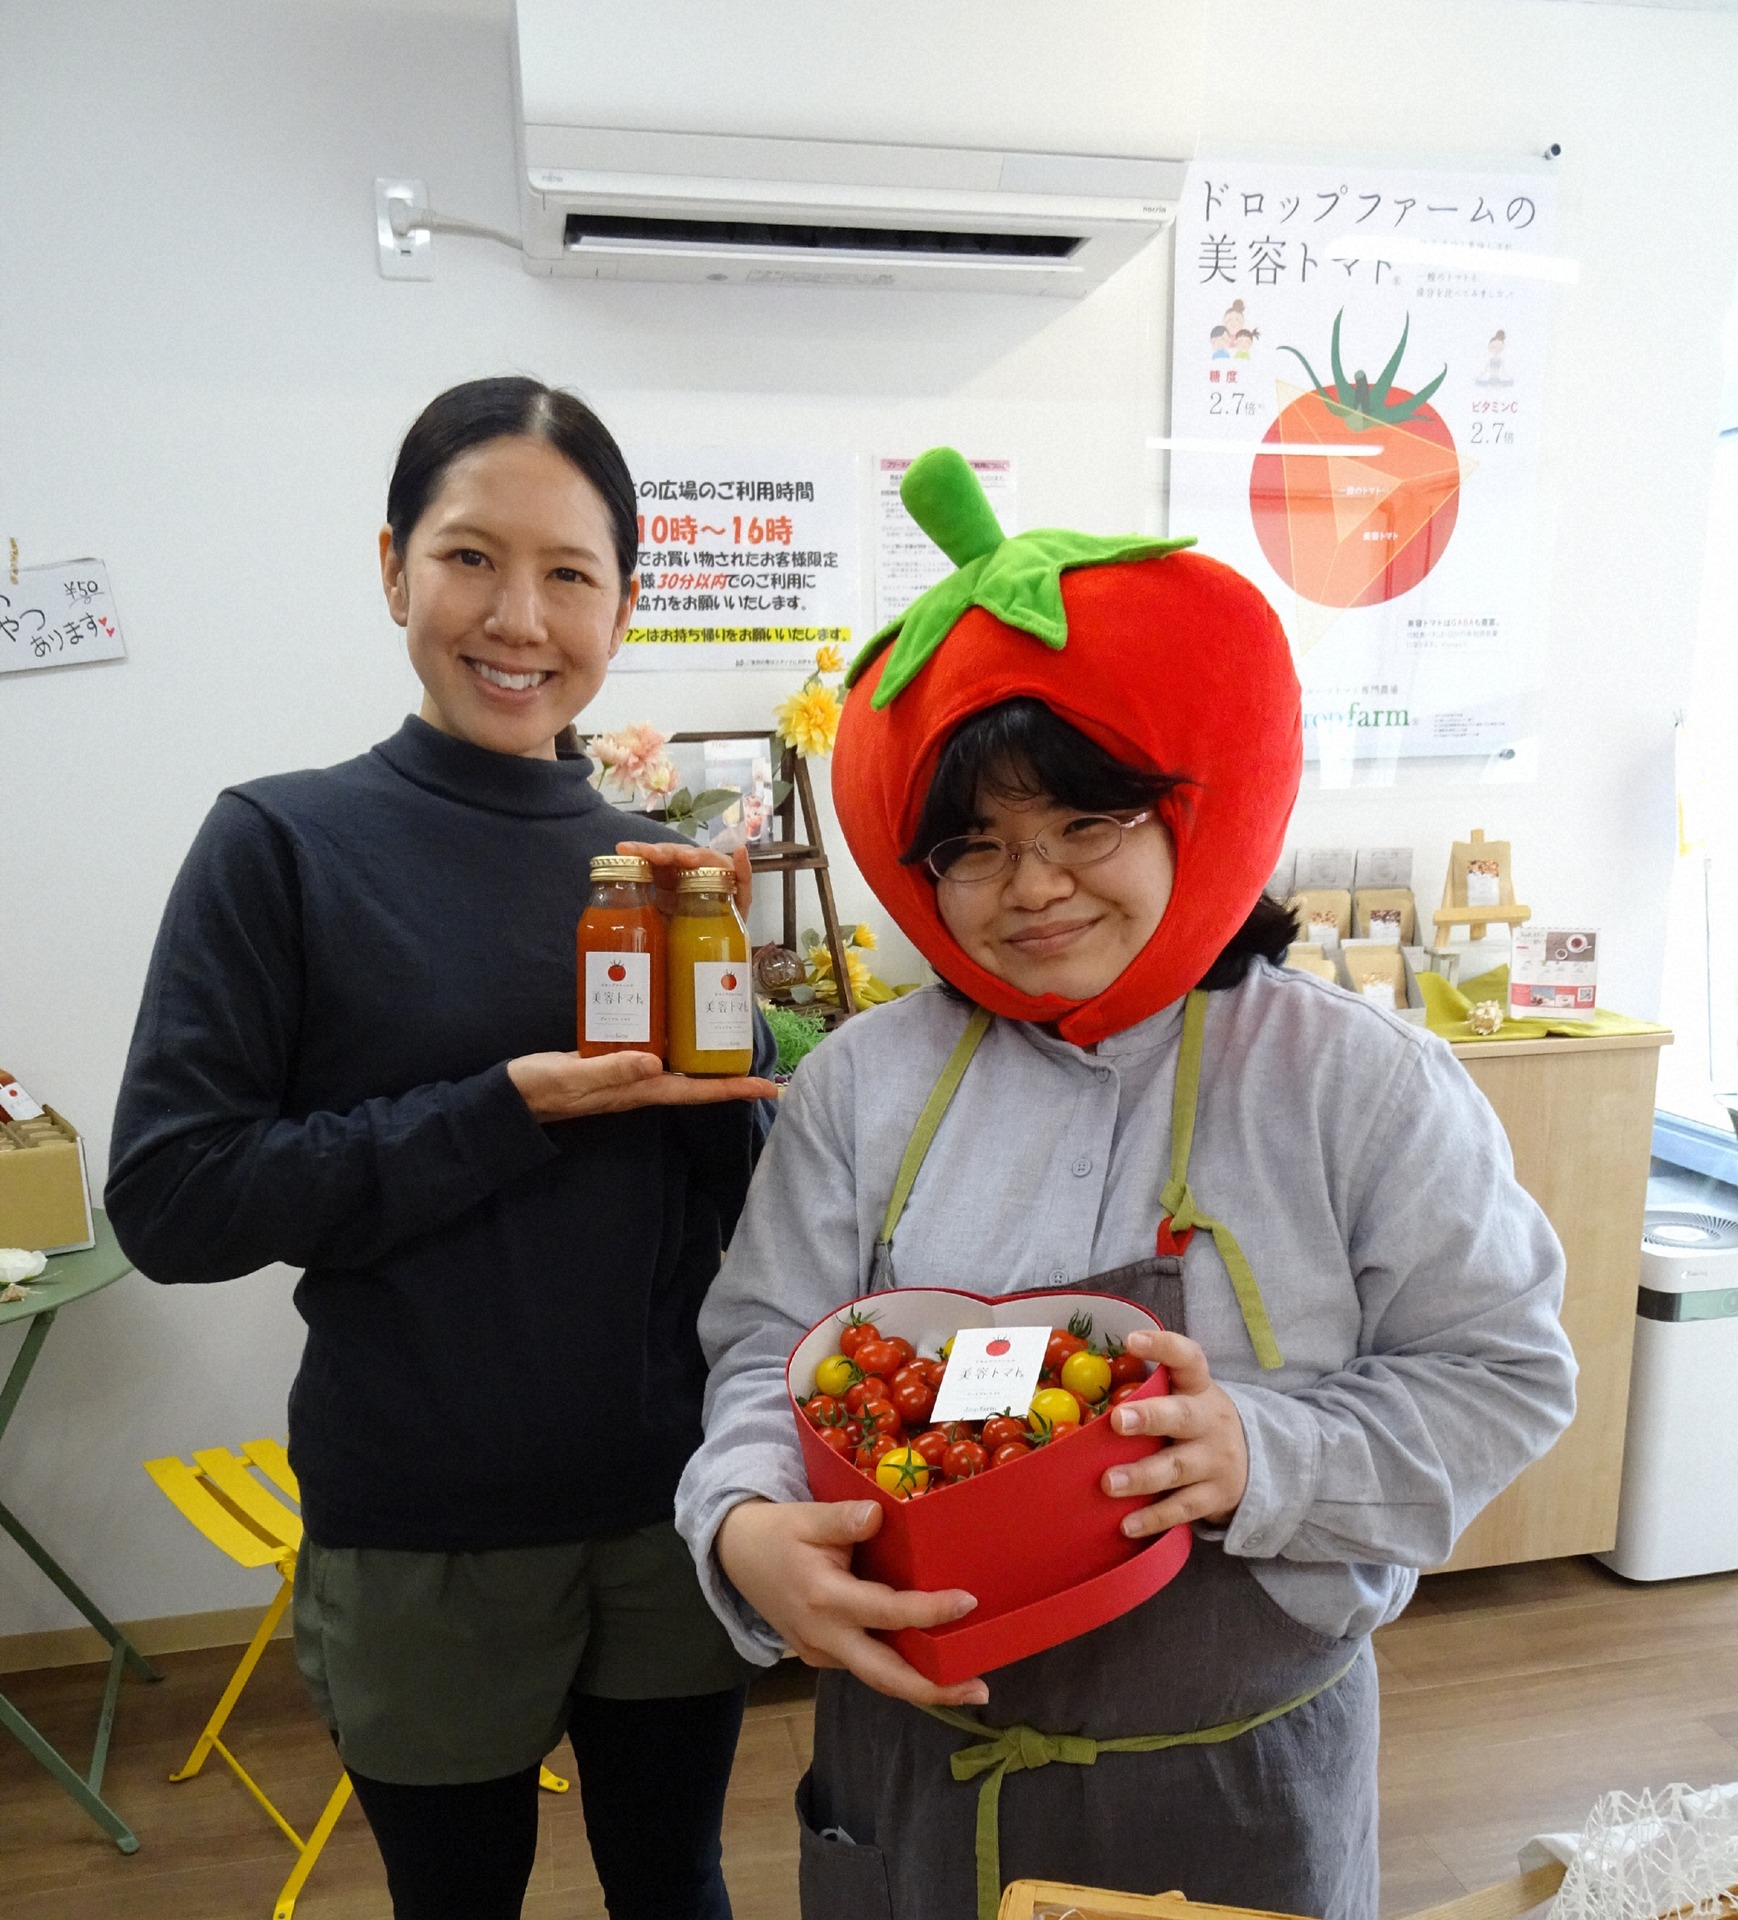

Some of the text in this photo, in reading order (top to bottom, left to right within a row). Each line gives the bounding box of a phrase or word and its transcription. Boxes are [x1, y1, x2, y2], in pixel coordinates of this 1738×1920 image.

[1203, 181, 1535, 229] ドロップファームの
[1209, 370, 1238, 383] 糖度
[1471, 400, 1519, 414] ビタミンC
[30, 612, 98, 658] あります
